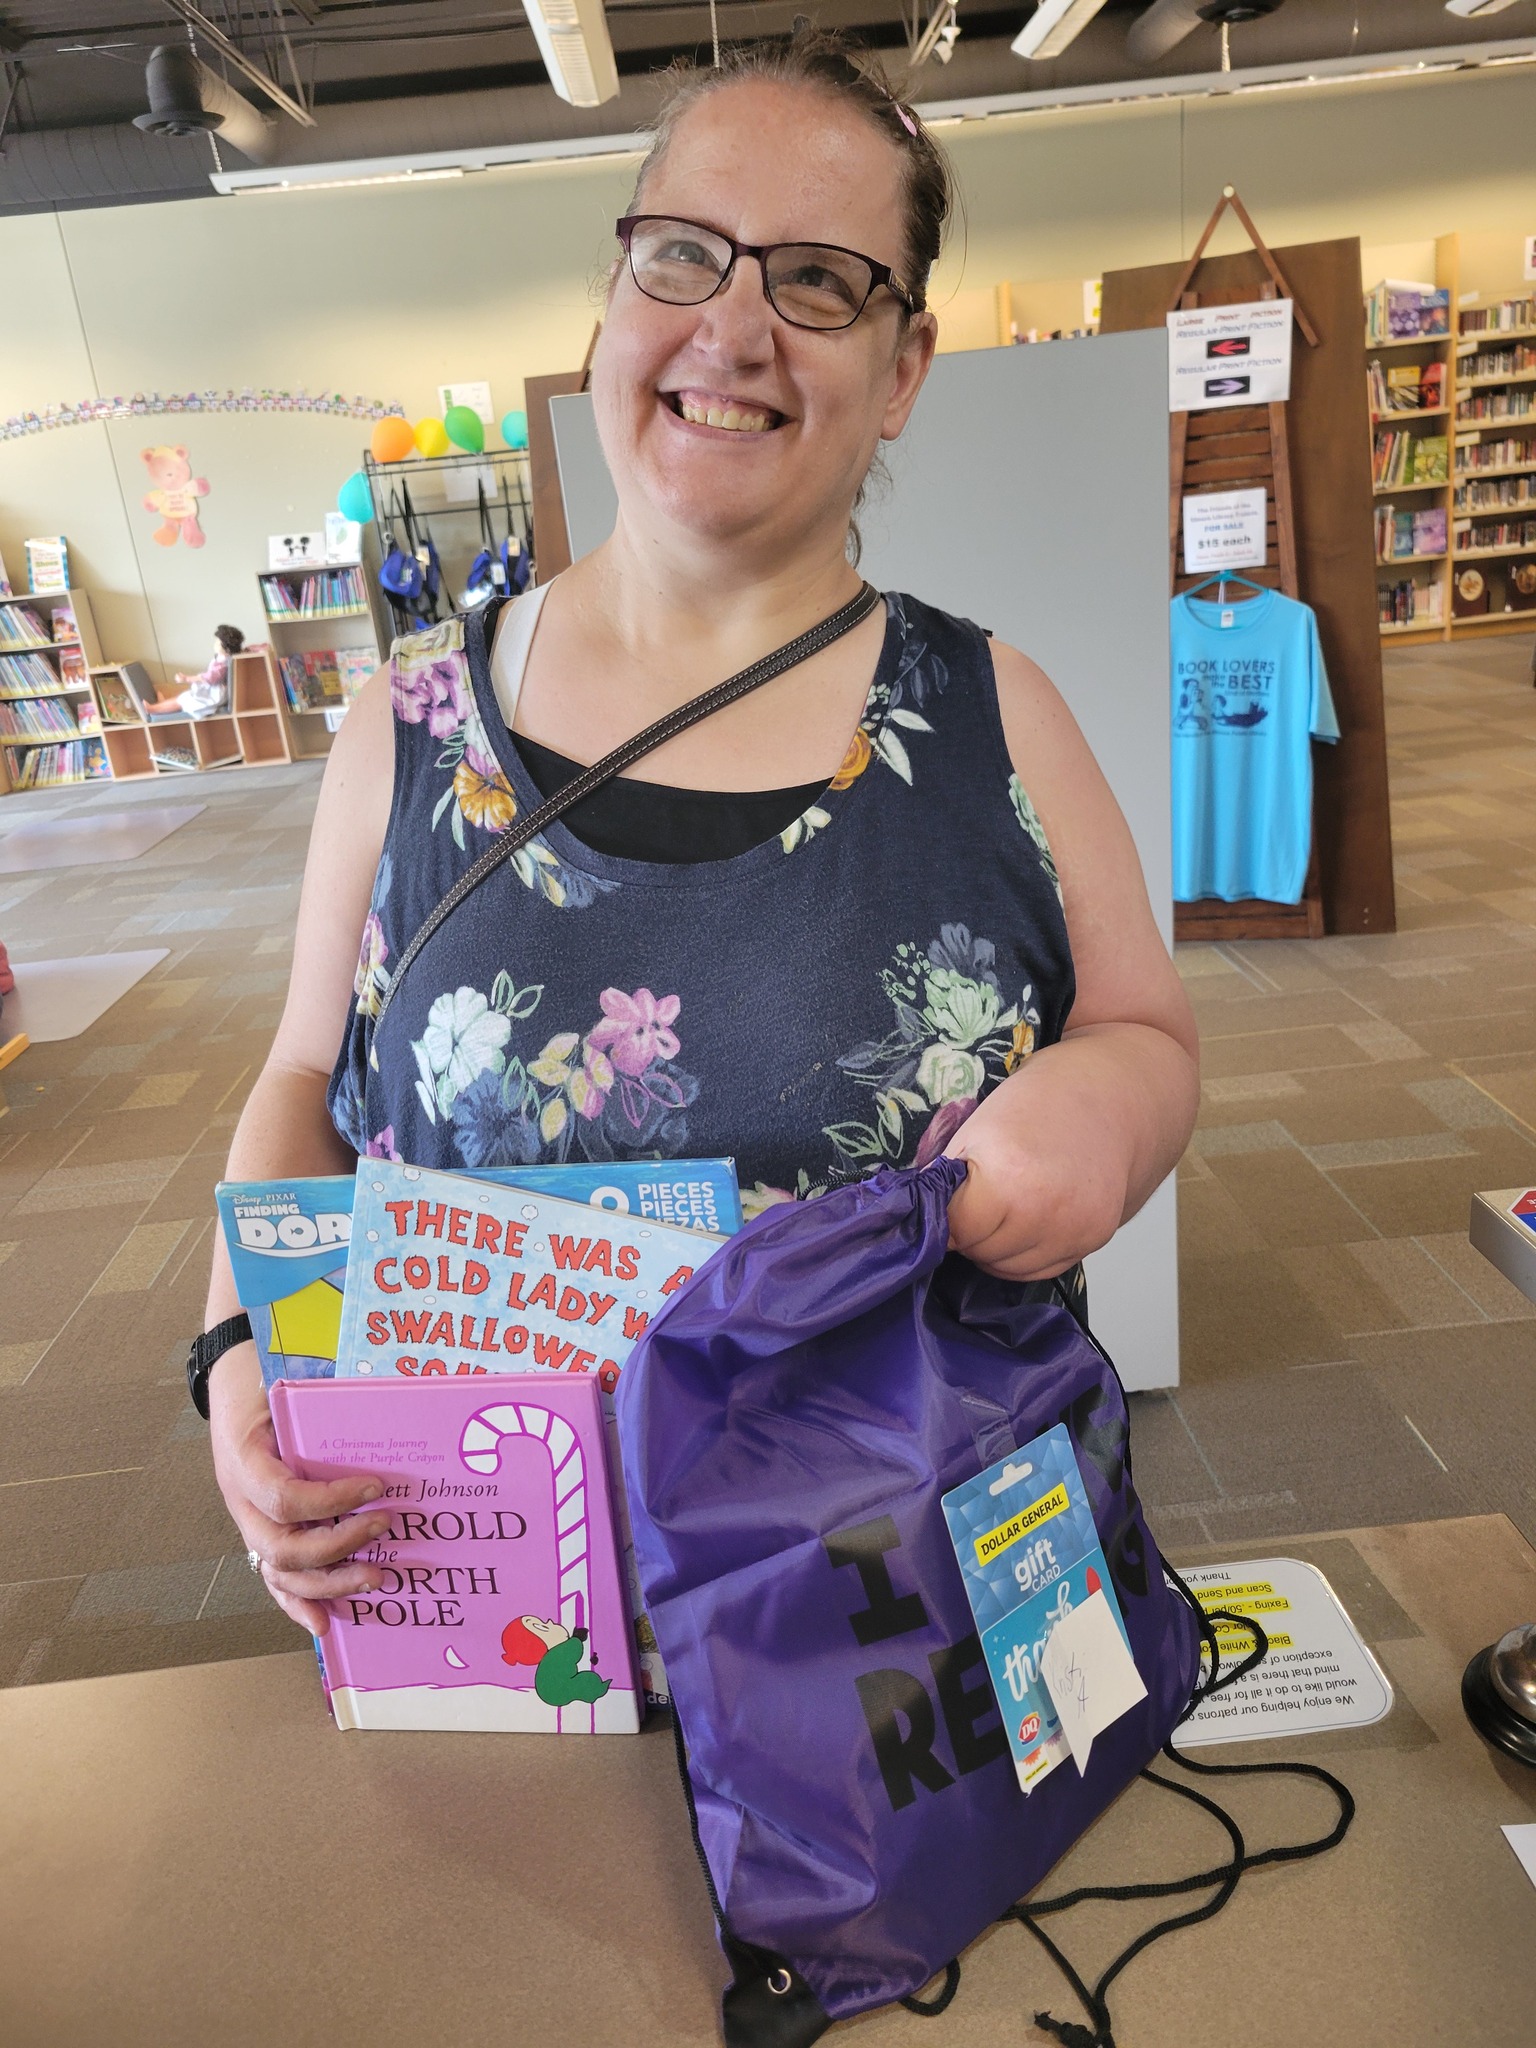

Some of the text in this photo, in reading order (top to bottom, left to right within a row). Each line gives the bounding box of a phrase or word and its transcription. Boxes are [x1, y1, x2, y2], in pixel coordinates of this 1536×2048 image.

[1198, 535, 1251, 549] $15 each
[1178, 659, 1275, 675] BOOK LOVERS
[1228, 674, 1272, 690] BEST
[638, 1181, 714, 1200] PIECES
[228, 1193, 297, 1205] Disney PIXAR
[234, 1203, 300, 1218] FINDING
[640, 1199, 717, 1217] PIECES
[237, 1213, 354, 1249] DOR
[385, 1200, 530, 1258] THERE
[547, 1234, 641, 1281] WAS
[374, 1255, 491, 1295] COLD
[507, 1272, 618, 1325] LADY
[320, 1438, 428, 1451] A Christmas Journey
[322, 1451, 445, 1465] with the Purple Crayon
[416, 1478, 499, 1502] Johnson
[981, 1493, 1063, 1556] DOLLAR GENERAL
[368, 1543, 398, 1562] the
[1015, 1538, 1057, 1592] gift
[367, 1567, 500, 1595] ORTH
[1032, 1564, 1060, 1592] CARD
[1200, 1571, 1231, 1583] Thank
[1198, 1583, 1272, 1600] Scan and Send
[1255, 1599, 1289, 1610] Faxing
[348, 1599, 465, 1627] POLE
[1220, 1640, 1250, 1651] White
[1268, 1635, 1291, 1645] Blac
[1270, 1655, 1280, 1666] of
[1283, 1650, 1333, 1663] exception
[1262, 1669, 1290, 1680] there
[1291, 1667, 1312, 1678] that
[1314, 1664, 1340, 1675] mind
[1249, 1673, 1259, 1682] is
[1325, 1678, 1357, 1690] would
[1251, 1688, 1262, 1699] all
[1265, 1687, 1272, 1697] it
[1275, 1686, 1288, 1696] do
[1291, 1684, 1302, 1693] to
[1304, 1682, 1324, 1692] like
[1234, 1691, 1248, 1701] for
[1303, 1696, 1332, 1708] enjoy
[1335, 1695, 1355, 1705] We
[1198, 1706, 1237, 1720] patrons
[1241, 1705, 1258, 1715] our
[1261, 1701, 1301, 1713] helping
[1020, 1716, 1040, 1740] DQ
